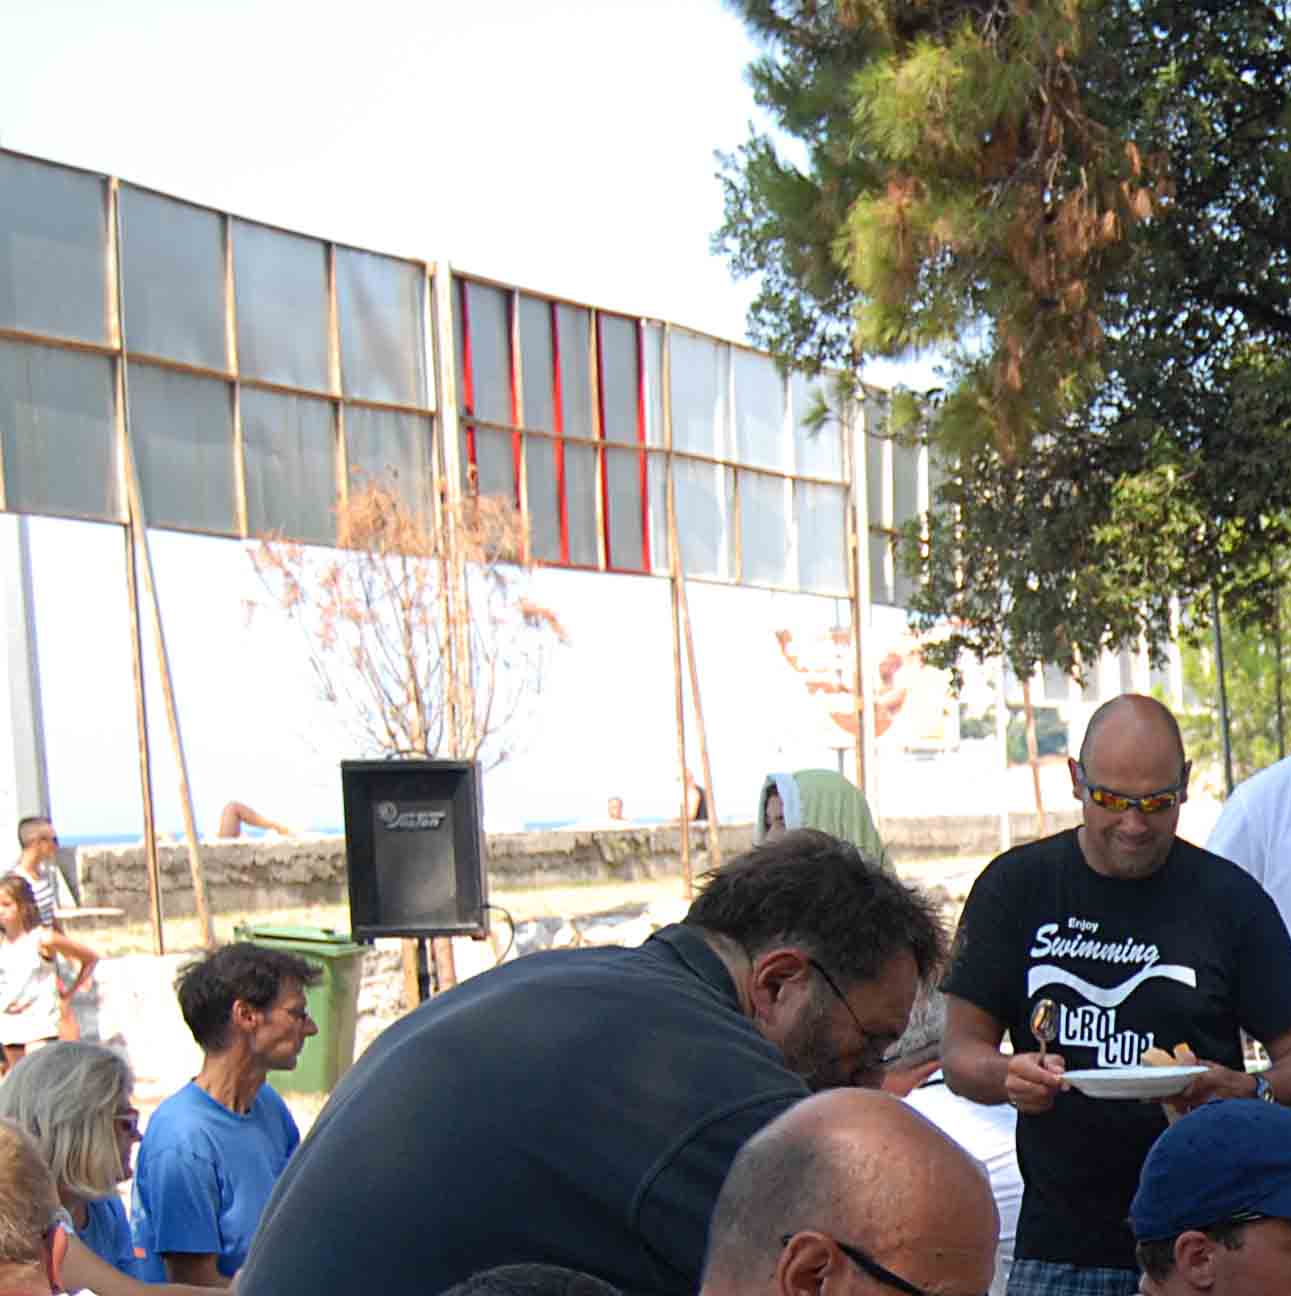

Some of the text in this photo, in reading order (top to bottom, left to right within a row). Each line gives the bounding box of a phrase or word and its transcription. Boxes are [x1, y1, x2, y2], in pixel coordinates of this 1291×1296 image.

[1067, 917, 1100, 933] Enjoy
[1030, 923, 1161, 966] Swimming
[1063, 1006, 1110, 1043] CRO
